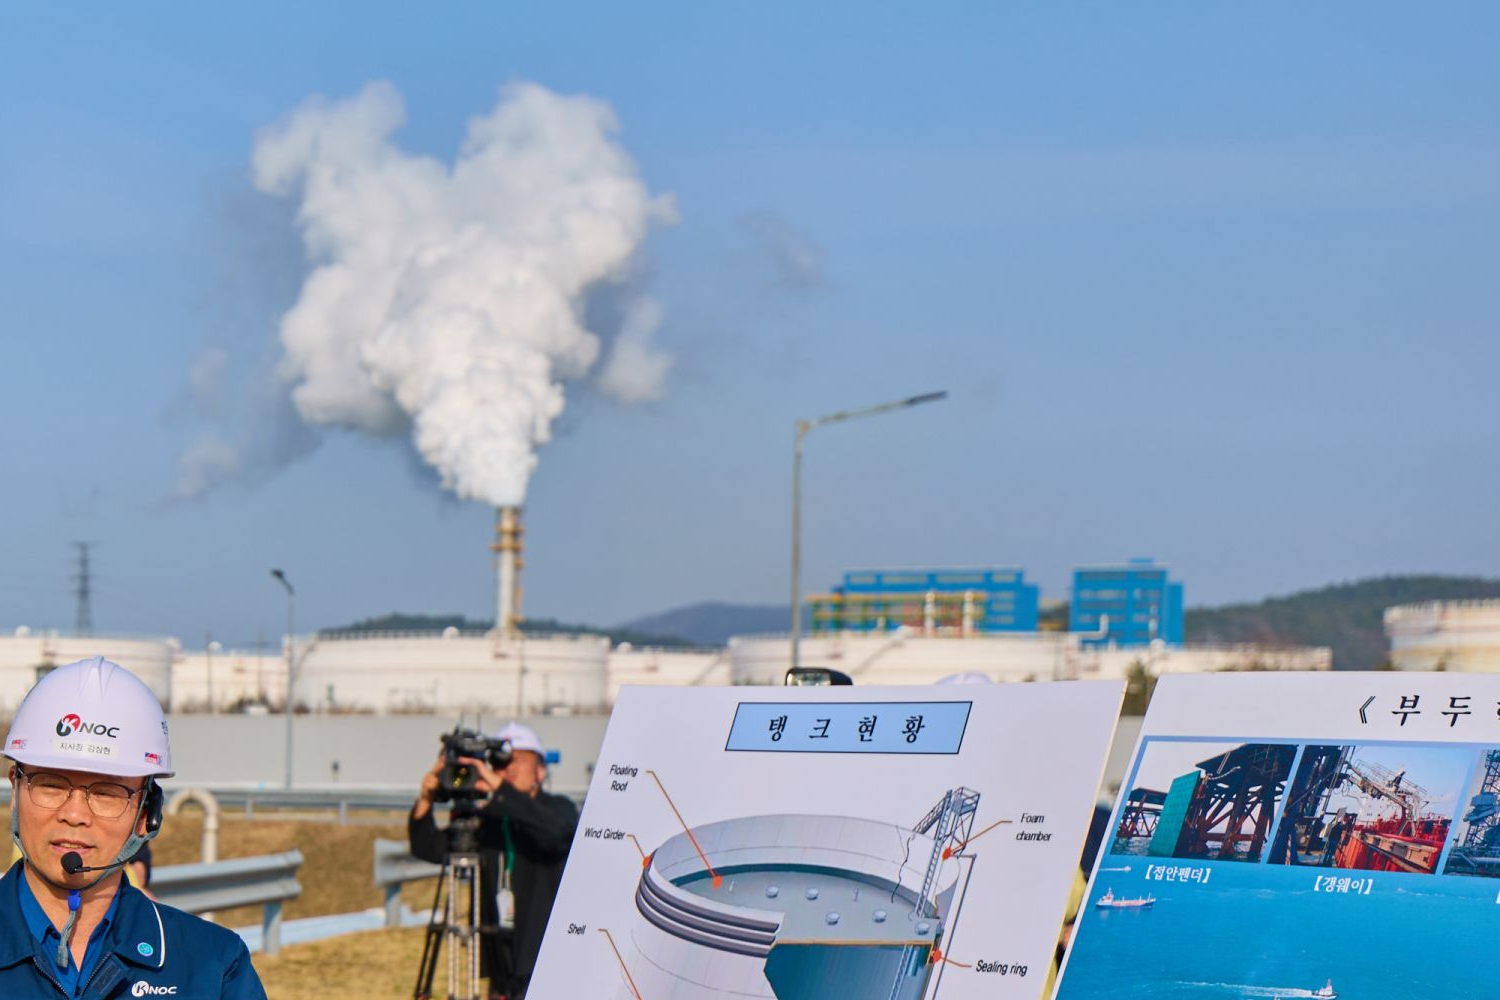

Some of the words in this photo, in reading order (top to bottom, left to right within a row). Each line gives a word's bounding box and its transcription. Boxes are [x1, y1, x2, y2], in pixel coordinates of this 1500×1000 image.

[610, 765, 638, 777] Floating
[611, 781, 628, 791] Roof
[1021, 814, 1045, 824] Foam
[585, 828, 601, 839] Wind
[603, 829, 626, 840] Girder
[1016, 831, 1052, 842] chamber
[568, 923, 586, 935] Shell
[976, 960, 1007, 975] Sealing
[1010, 963, 1028, 977] ring
[132, 980, 178, 997] KNOC
